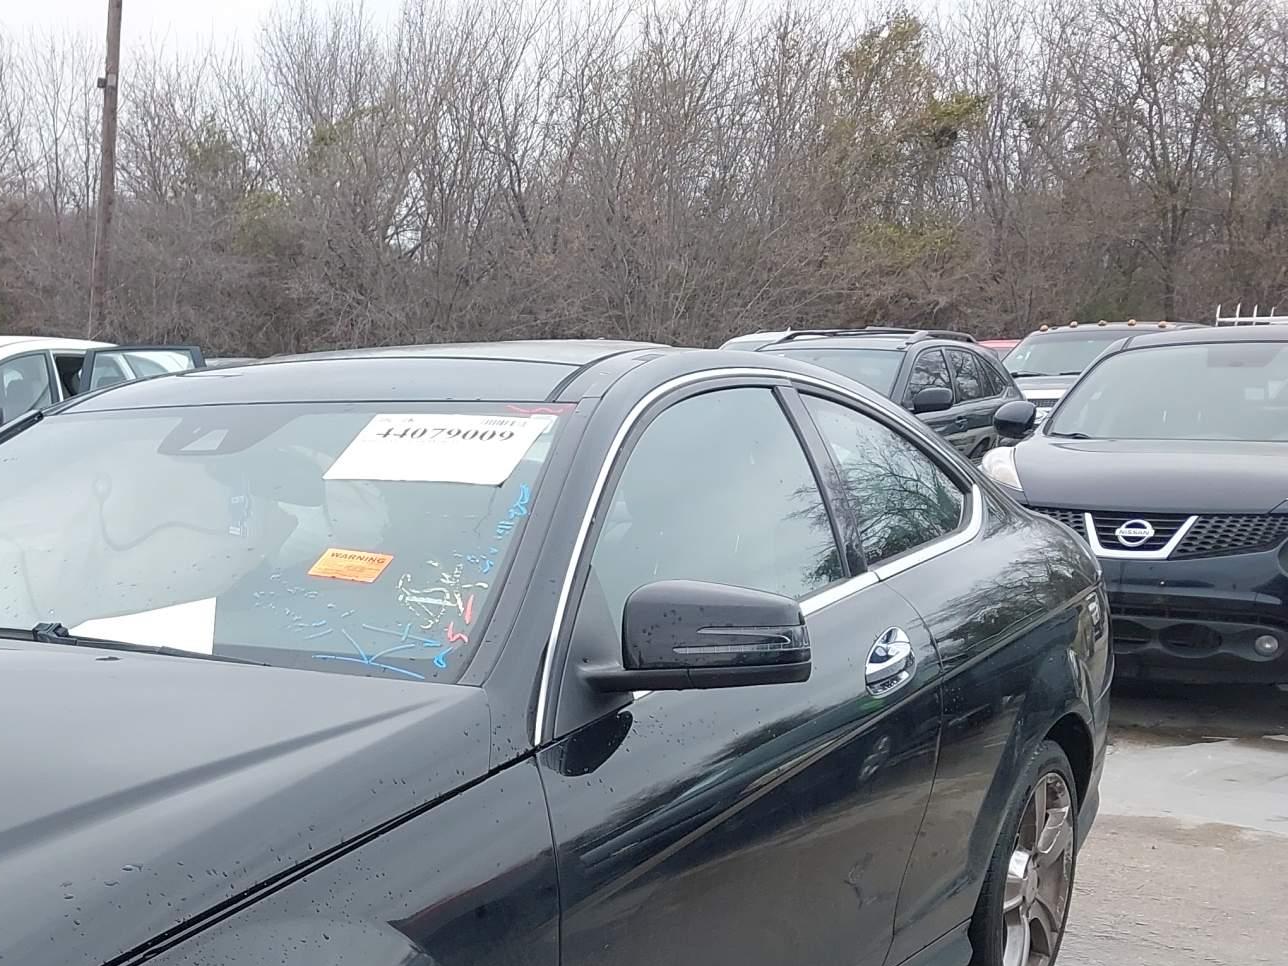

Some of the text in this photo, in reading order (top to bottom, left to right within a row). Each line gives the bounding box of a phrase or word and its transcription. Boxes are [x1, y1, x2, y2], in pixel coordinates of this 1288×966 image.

[376, 426, 515, 441] 44079009
[1119, 529, 1150, 537] NISSAN
[330, 552, 386, 564] WARNING
